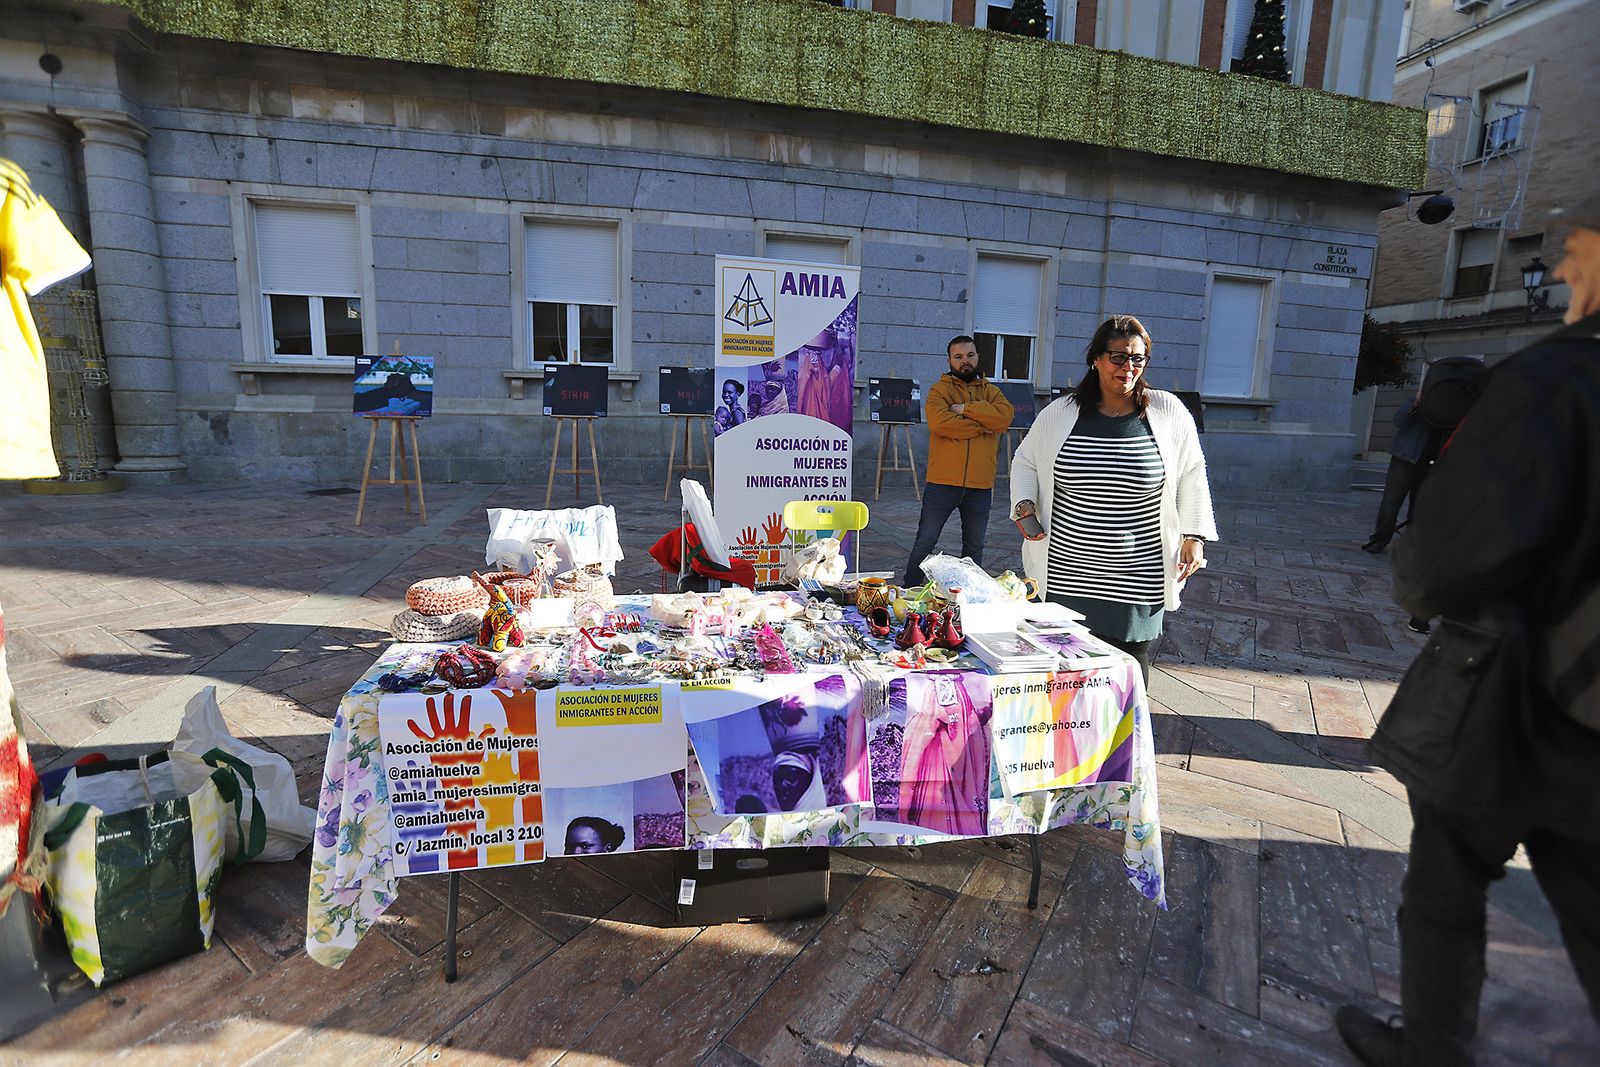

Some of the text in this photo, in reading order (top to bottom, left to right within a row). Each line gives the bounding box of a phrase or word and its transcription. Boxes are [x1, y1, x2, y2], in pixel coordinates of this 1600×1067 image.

[1328, 246, 1348, 255] PLAZA
[1327, 256, 1336, 264] DE
[780, 271, 847, 299] AMIA
[562, 390, 589, 400] SIRIA
[756, 436, 848, 451] ASOCIACIÓN DE
[794, 458, 848, 470] MUJERES
[746, 476, 847, 488] INMIGRANTES EN
[1024, 679, 1084, 694] Inmigrantes
[1087, 676, 1111, 688] AMIA
[560, 693, 658, 705] ASOCIACIÓN DE MUJERES
[560, 708, 614, 718] INMIGRANTES
[629, 704, 658, 715] ACCIÓN
[386, 739, 462, 756] Asociación
[466, 739, 483, 751] de
[388, 764, 480, 780] @amiahuelva
[1020, 759, 1055, 772] Huelva
[394, 809, 485, 828] @amiahuelva
[395, 840, 412, 856] C/
[416, 836, 467, 853] Jazmín,
[470, 829, 502, 846] local
[506, 828, 514, 841] 3
